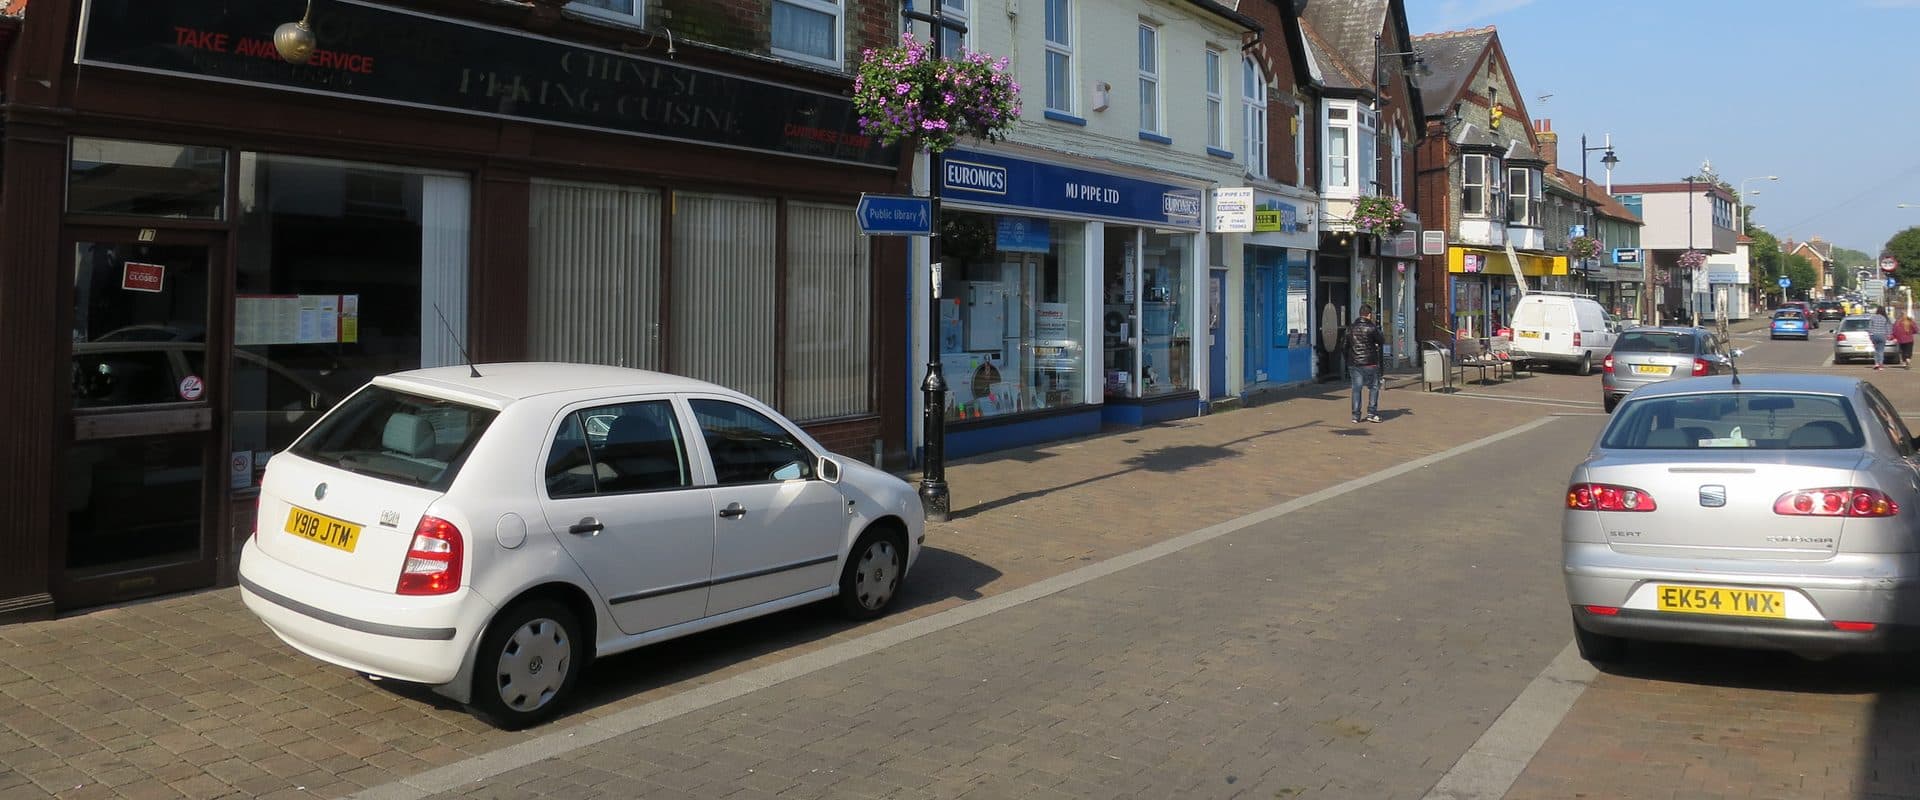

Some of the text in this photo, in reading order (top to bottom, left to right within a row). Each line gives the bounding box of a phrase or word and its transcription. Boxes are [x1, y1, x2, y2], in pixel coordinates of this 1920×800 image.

[175, 27, 229, 53] TAKE
[235, 37, 285, 61] AWA
[312, 49, 375, 74] ERVICE
[948, 164, 1004, 190] EURONICS
[1065, 182, 1120, 205] MJ PIPE LTD
[869, 208, 893, 220] Public
[293, 511, 351, 548] Y918 JTM
[1663, 588, 1775, 614] EK54 YWX
